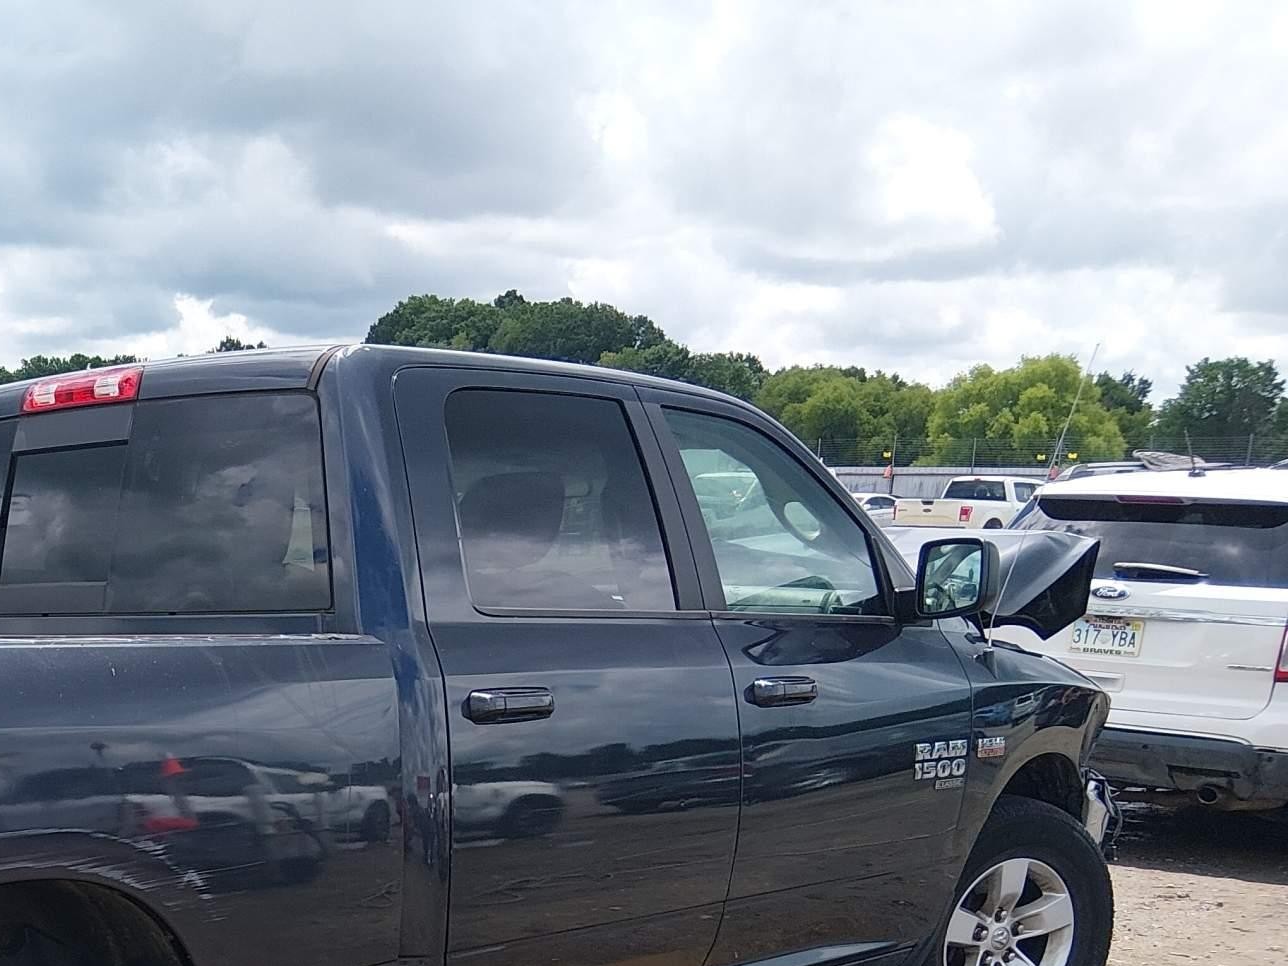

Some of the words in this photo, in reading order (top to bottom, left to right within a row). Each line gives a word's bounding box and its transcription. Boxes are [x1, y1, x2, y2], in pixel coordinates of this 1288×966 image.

[1072, 628, 1101, 645] 317
[1111, 630, 1136, 649] YBA
[914, 739, 968, 761] RAM
[914, 758, 966, 780] 1500
